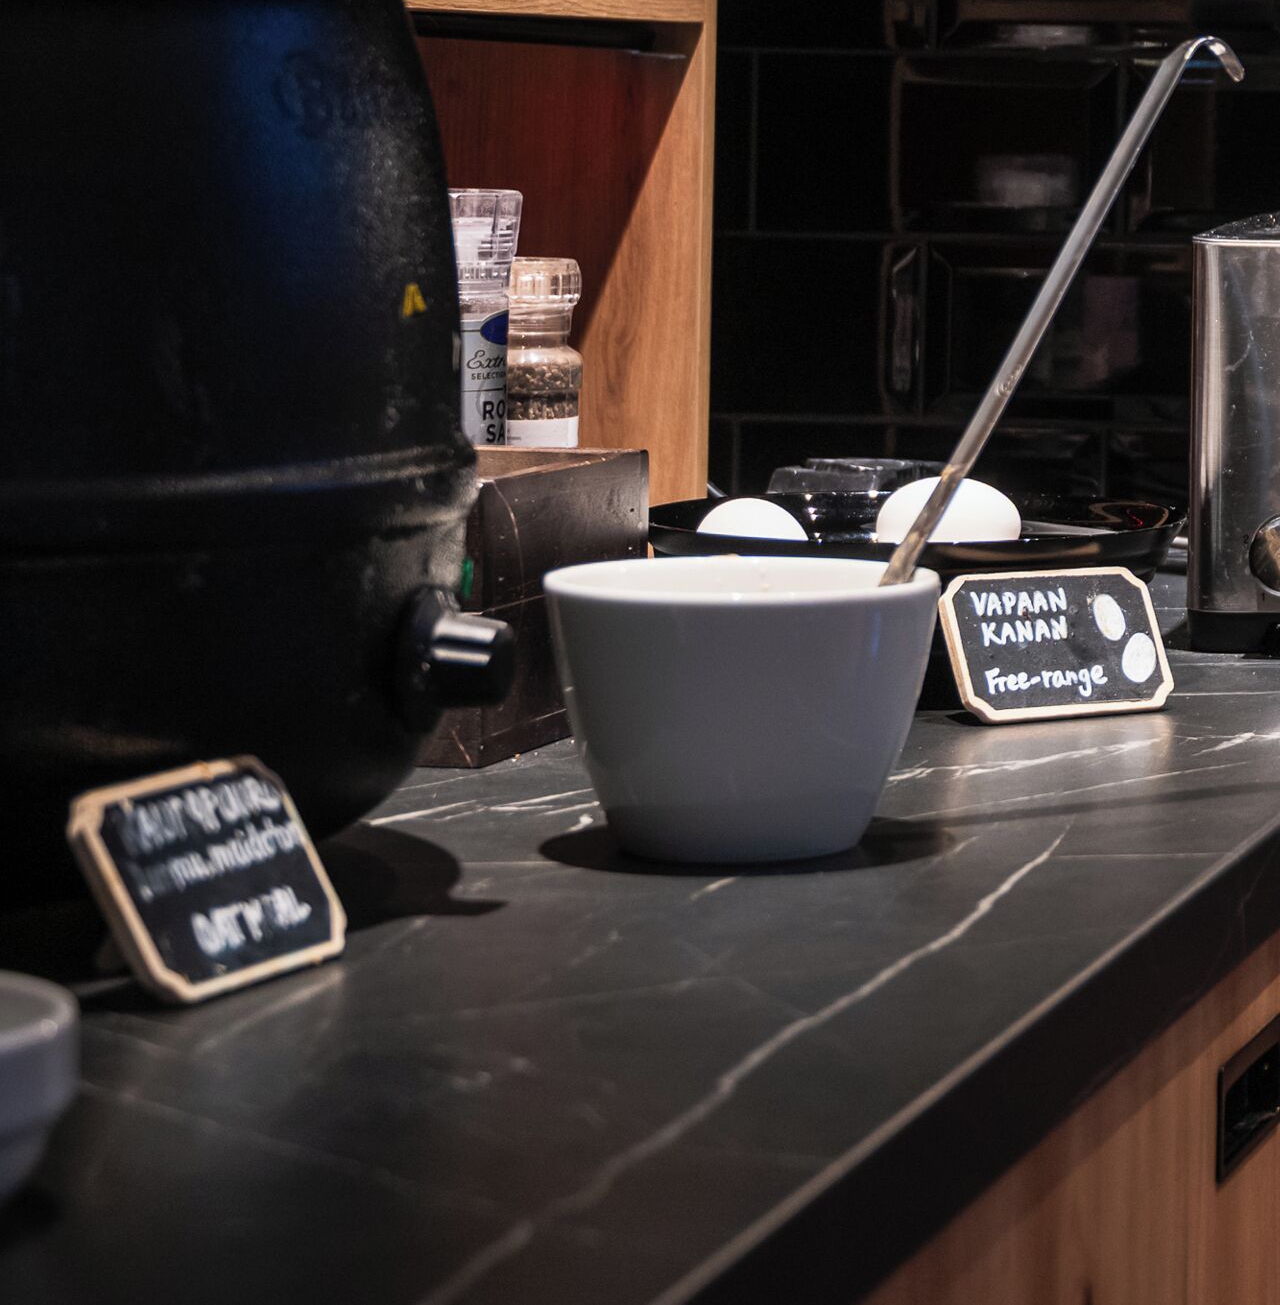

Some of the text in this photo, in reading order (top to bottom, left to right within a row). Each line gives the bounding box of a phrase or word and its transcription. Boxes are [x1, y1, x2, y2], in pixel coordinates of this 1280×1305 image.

[1243, 535, 1250, 544] 2
[969, 587, 1068, 617] VAPAAN
[981, 615, 1069, 647] KANAN
[984, 664, 1108, 697] Free-range
